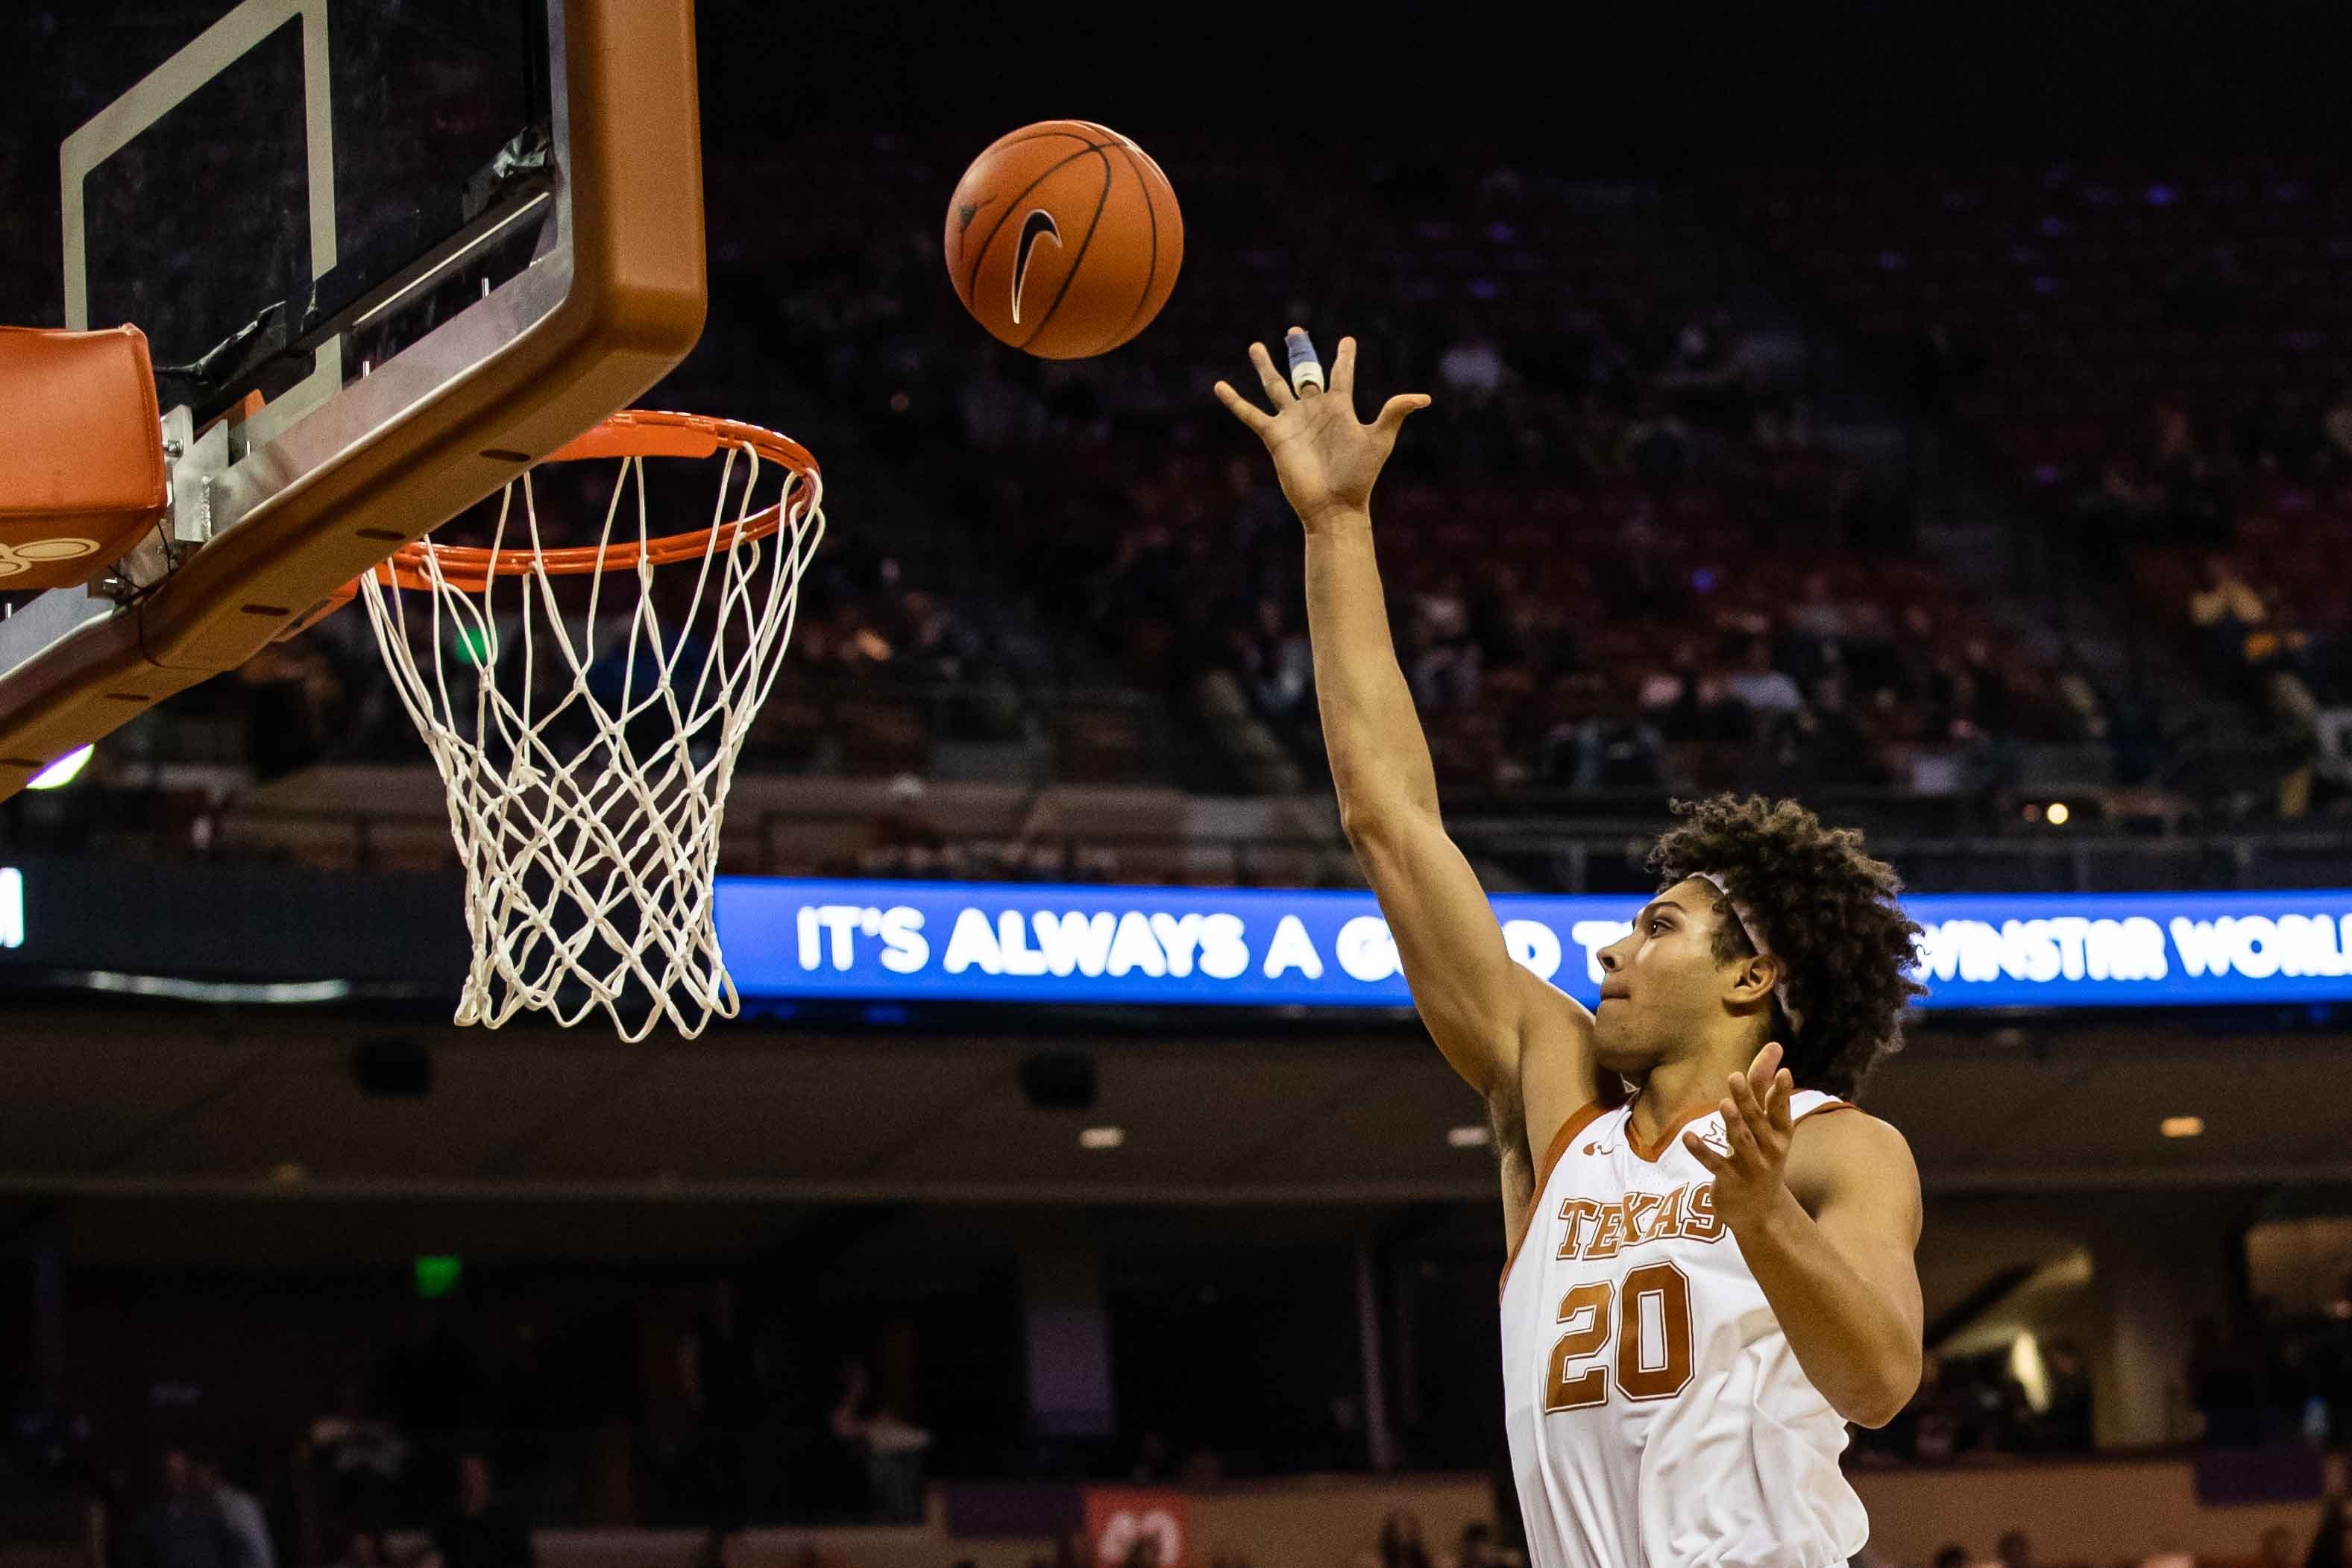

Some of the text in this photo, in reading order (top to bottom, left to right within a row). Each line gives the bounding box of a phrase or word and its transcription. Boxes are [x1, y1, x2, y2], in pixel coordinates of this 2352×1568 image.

[796, 905, 930, 975] IT'S
[943, 907, 1250, 979] ALWAYS
[1263, 915, 1323, 979] A
[1336, 916, 1562, 981] GD
[2169, 913, 2352, 979] WORL
[1556, 1181, 1727, 1261] TEXAS
[1544, 1260, 1695, 1415] 20
